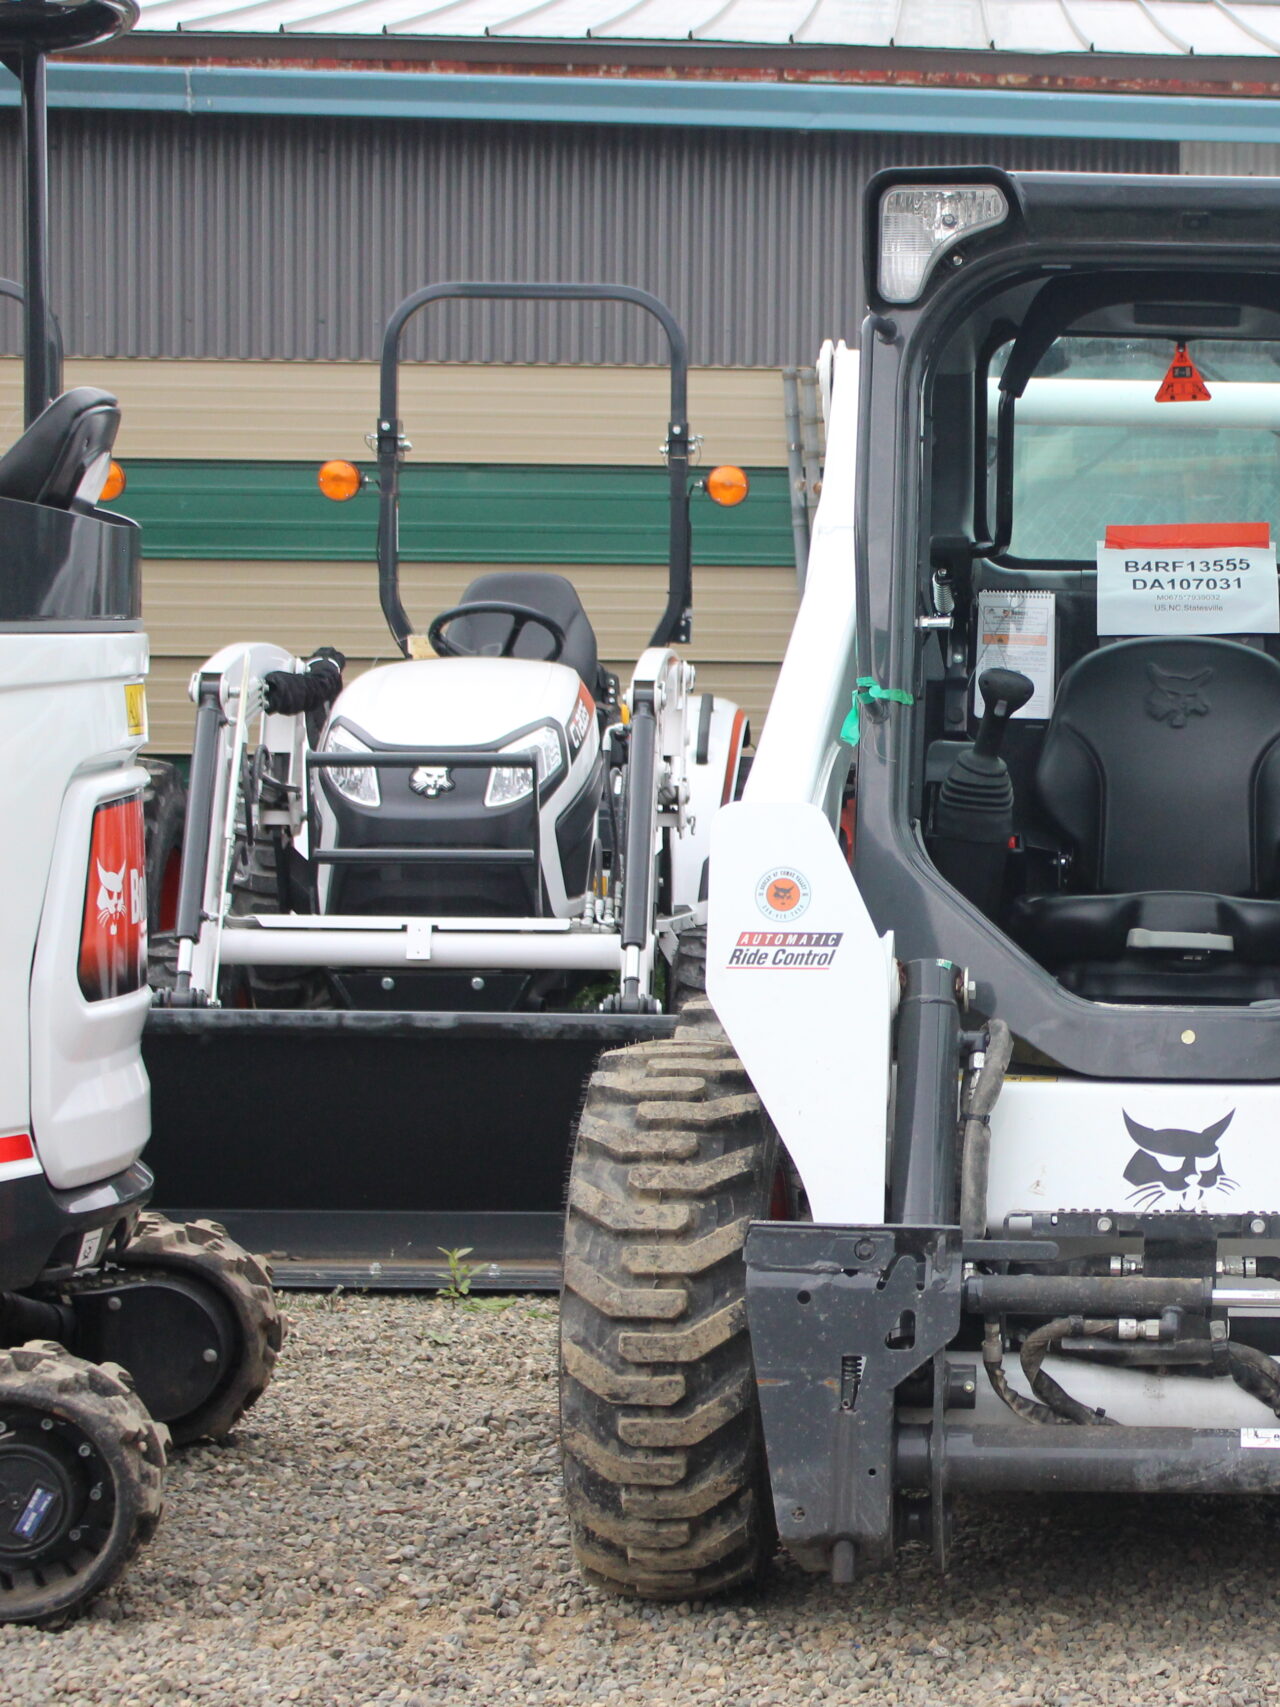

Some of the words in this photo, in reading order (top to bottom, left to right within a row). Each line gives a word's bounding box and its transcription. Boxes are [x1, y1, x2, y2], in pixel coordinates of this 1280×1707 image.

[1124, 558, 1251, 573] B4RF13555
[1132, 577, 1242, 591] DA107031
[739, 933, 838, 946] AUTOMATIC
[728, 948, 769, 966] Ride
[771, 948, 836, 966] Control
